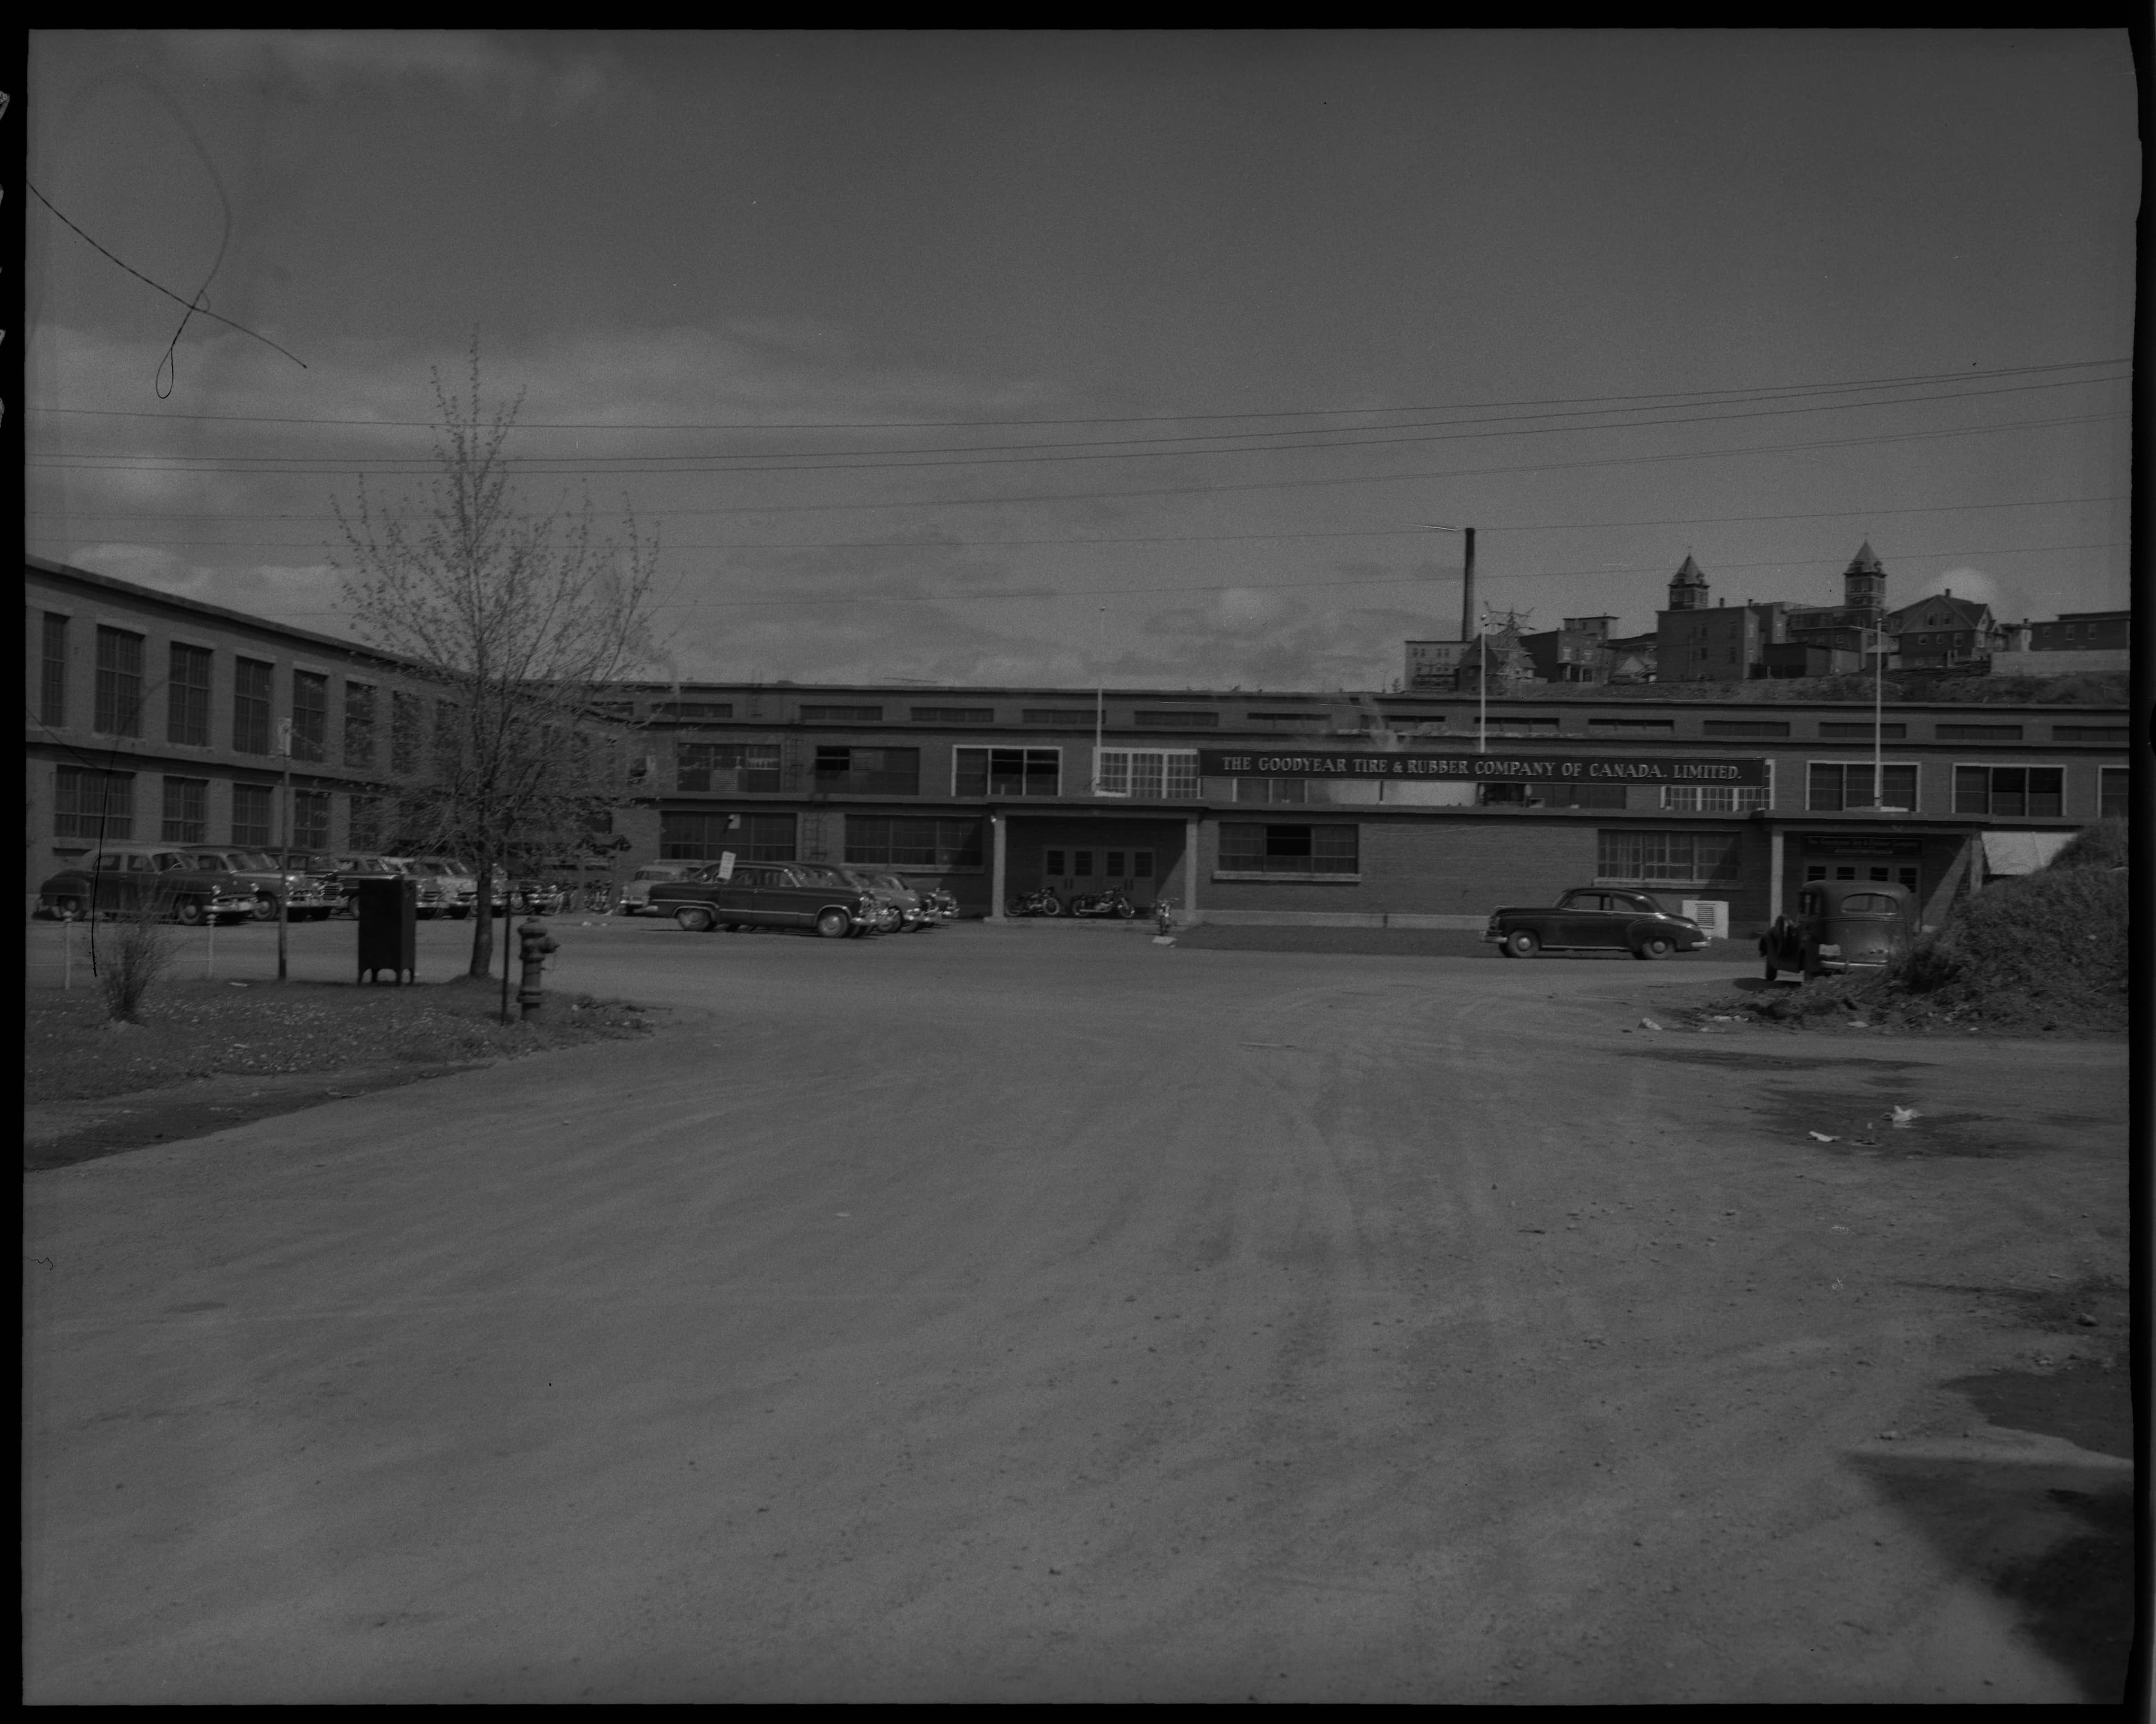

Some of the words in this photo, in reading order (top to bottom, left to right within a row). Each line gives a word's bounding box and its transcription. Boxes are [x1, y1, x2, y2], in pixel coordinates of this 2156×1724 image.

[1222, 757, 1251, 771] THE
[1258, 757, 1347, 772] GOODYEAR
[1353, 759, 1388, 773] TIRE
[1392, 761, 1403, 773] &
[1406, 760, 1469, 774] RUBBER
[1474, 761, 1557, 776] COMPANY
[1561, 762, 1583, 777] OF
[1673, 764, 1743, 779] LIMITED.
